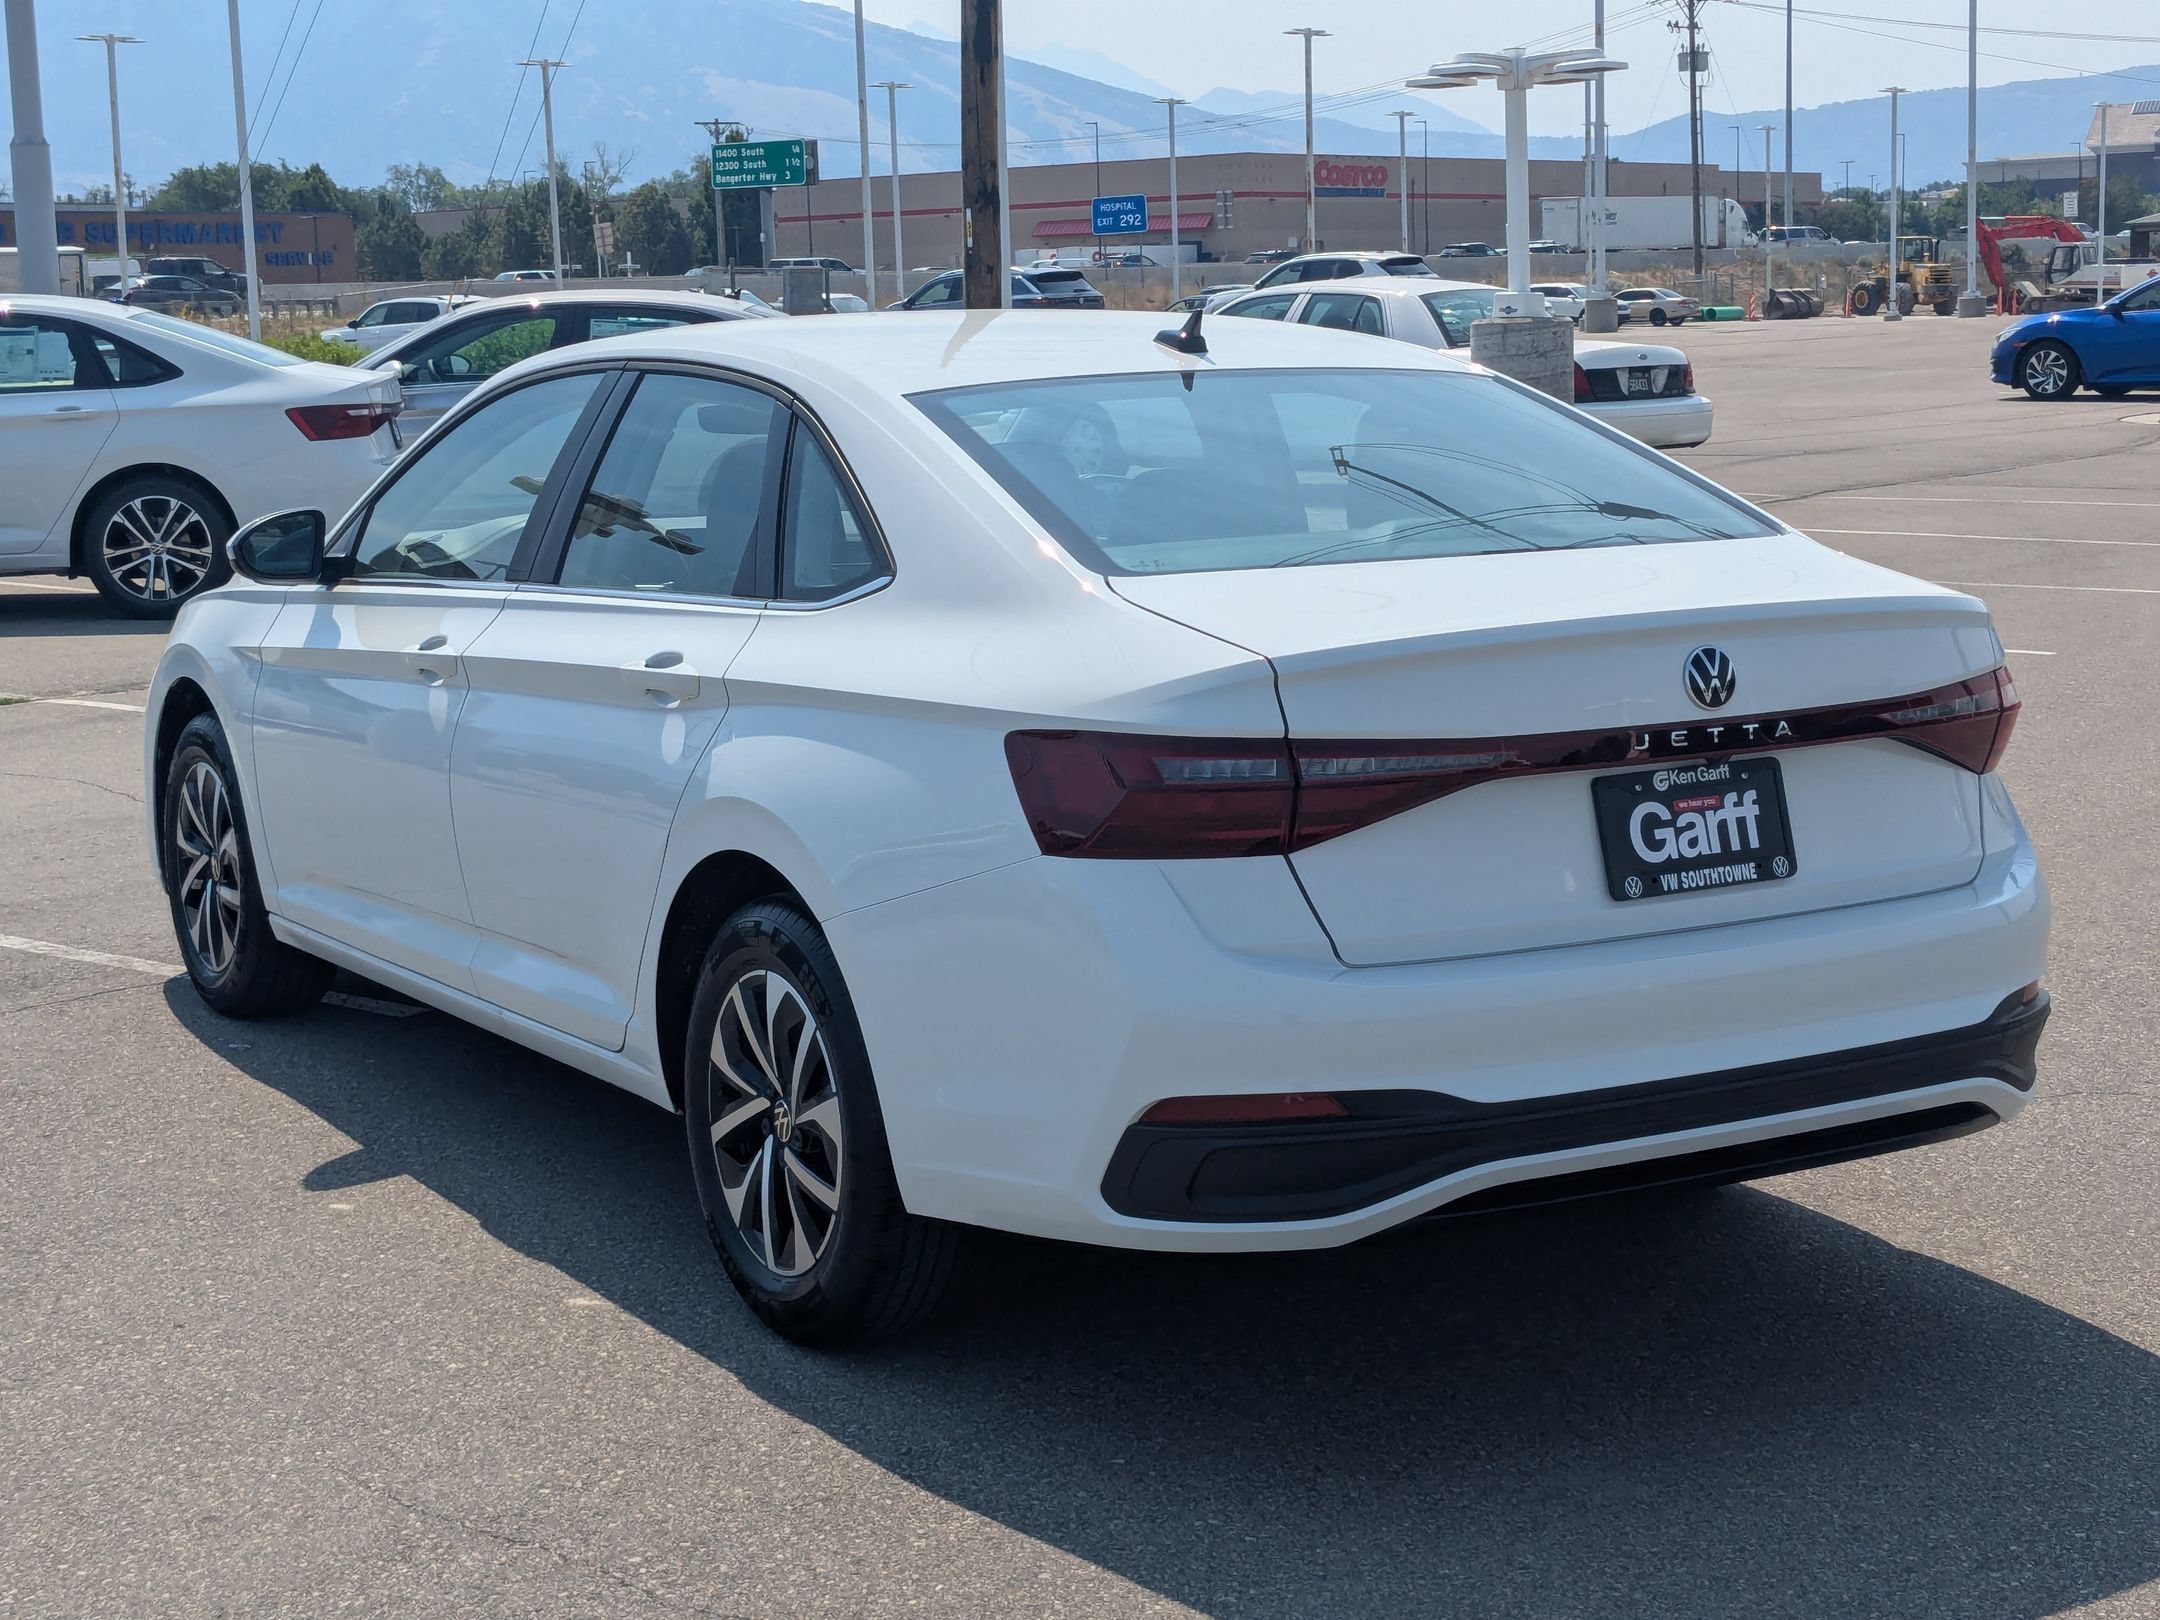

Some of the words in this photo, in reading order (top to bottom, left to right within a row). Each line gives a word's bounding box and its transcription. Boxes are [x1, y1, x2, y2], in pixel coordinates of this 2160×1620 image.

[715, 148, 738, 158] 11400
[741, 147, 765, 157] South
[715, 161, 739, 171] 12300
[743, 160, 767, 169] South
[715, 173, 756, 185] Bangerter
[759, 172, 777, 182] Hwy
[785, 171, 791, 180] 3
[1100, 201, 1137, 212] HOSPITAL
[1097, 217, 1113, 227] EXIT
[1119, 213, 1143, 227] 292
[1634, 720, 1792, 750] JETTA
[1668, 769, 1697, 786] Ken
[1697, 764, 1730, 783] Garff
[1629, 789, 1760, 864] Garff
[1660, 874, 1679, 892] VW
[1681, 862, 1758, 889] SOUTHTOWNE
